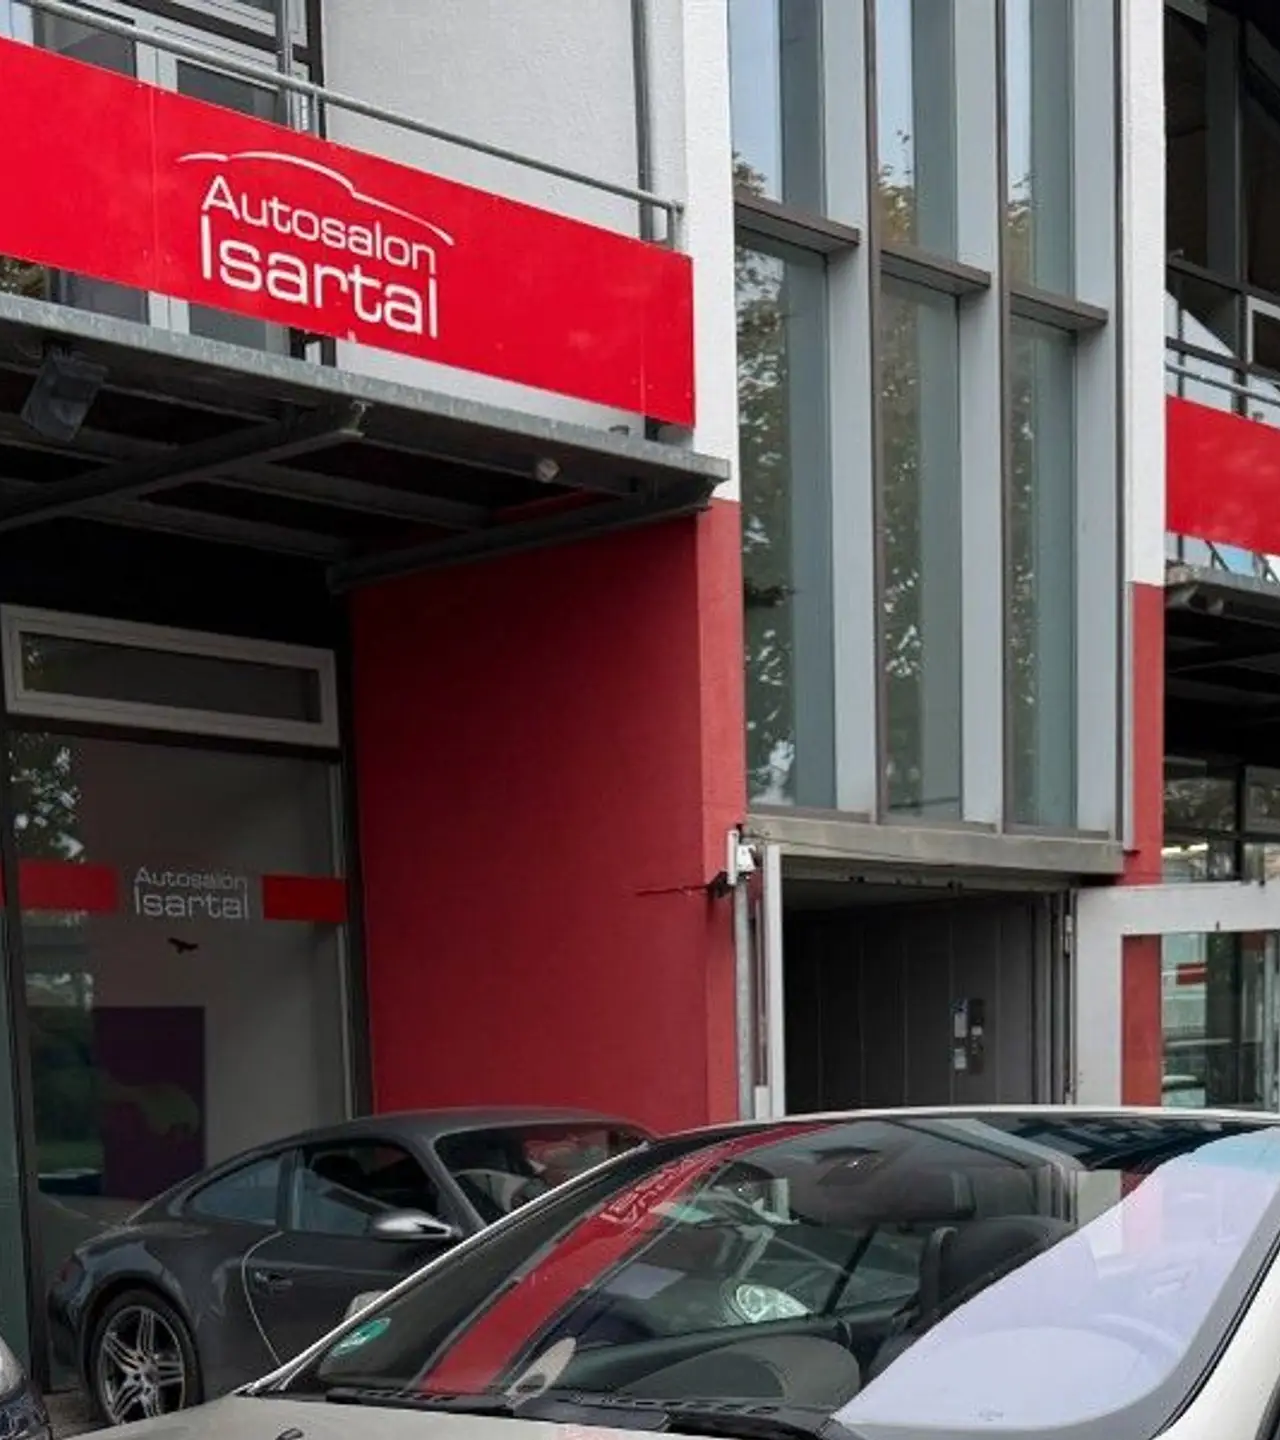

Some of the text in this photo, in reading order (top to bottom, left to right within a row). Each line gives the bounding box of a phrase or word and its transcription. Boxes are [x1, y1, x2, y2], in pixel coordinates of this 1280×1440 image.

[200, 175, 436, 274] Autosalon
[200, 213, 438, 339] Isartal
[134, 866, 248, 891] Autosalon
[134, 885, 249, 919] Isartal
